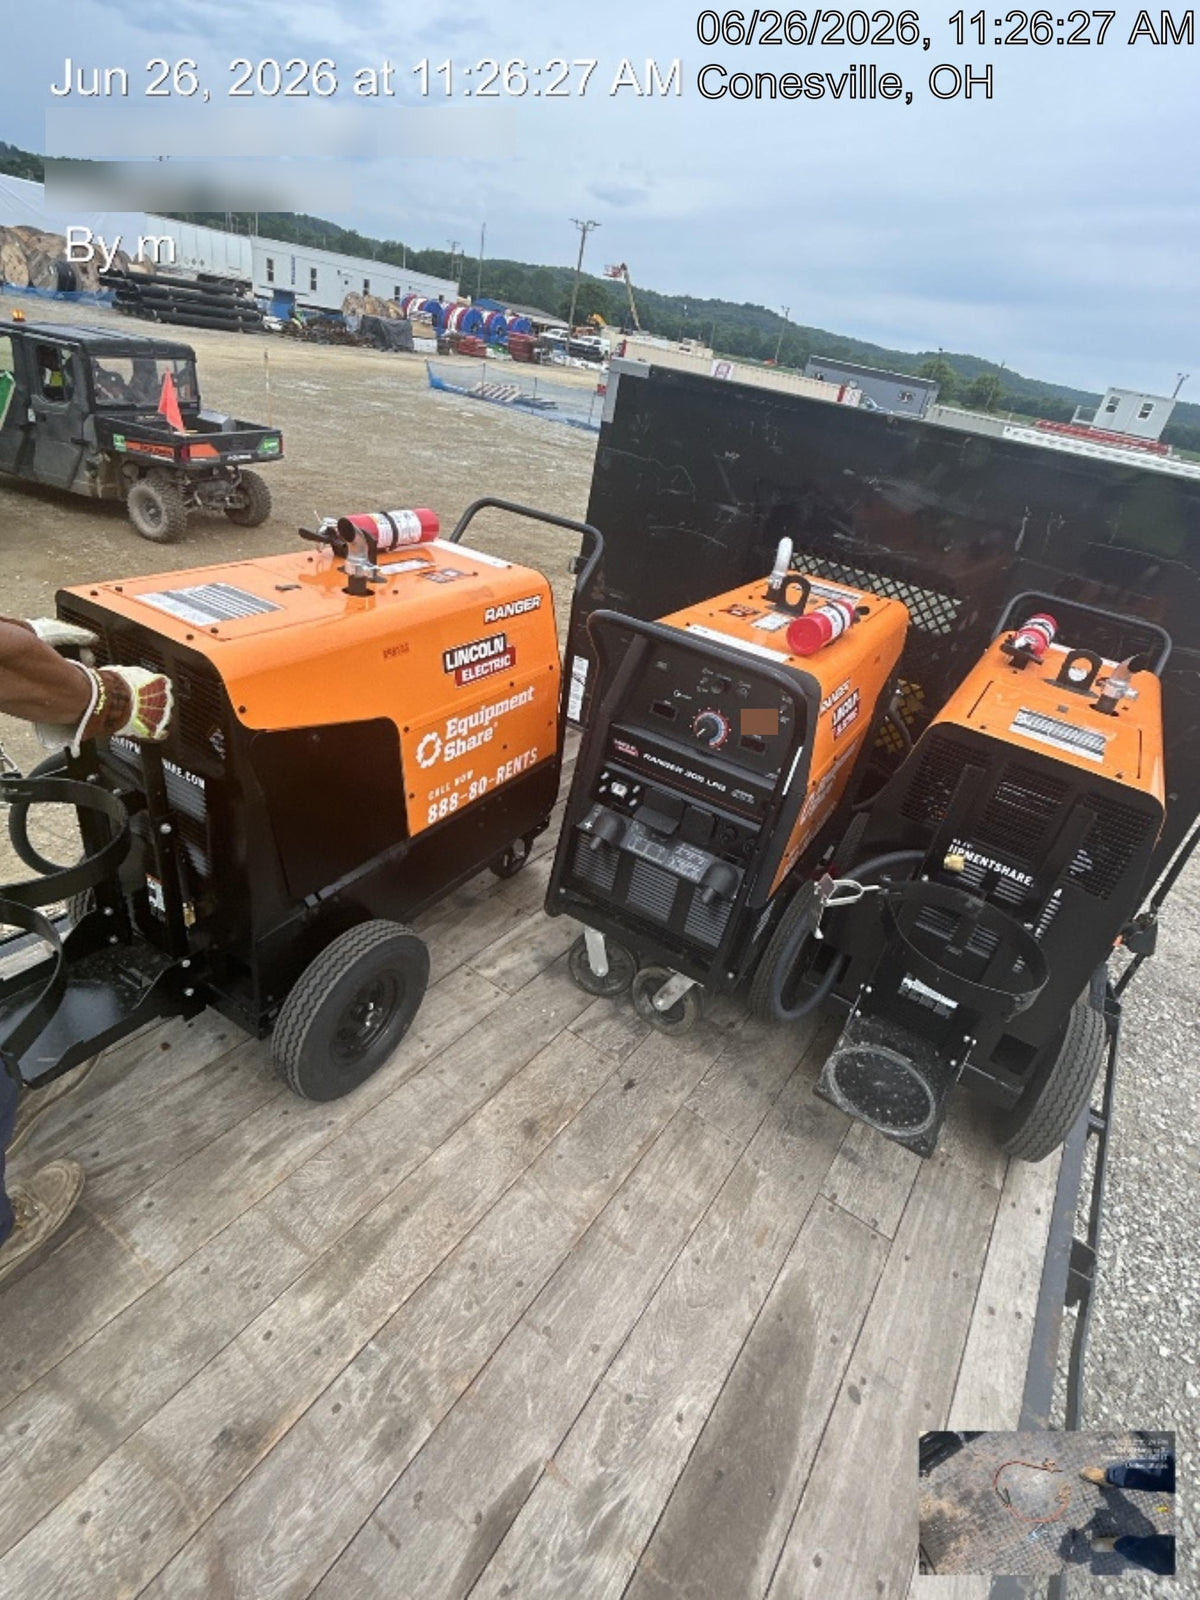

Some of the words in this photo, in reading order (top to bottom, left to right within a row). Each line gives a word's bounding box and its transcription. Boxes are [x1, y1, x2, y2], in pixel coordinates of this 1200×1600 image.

[483, 595, 542, 625] RANGER
[445, 636, 504, 671] LINCOLN
[461, 653, 512, 683] ELECTRIC
[445, 685, 535, 740] Equipment
[443, 727, 494, 763] Share
[427, 747, 539, 825] 888-80-RENTS
[428, 782, 452, 801] CALL
[454, 769, 474, 787] NOW
